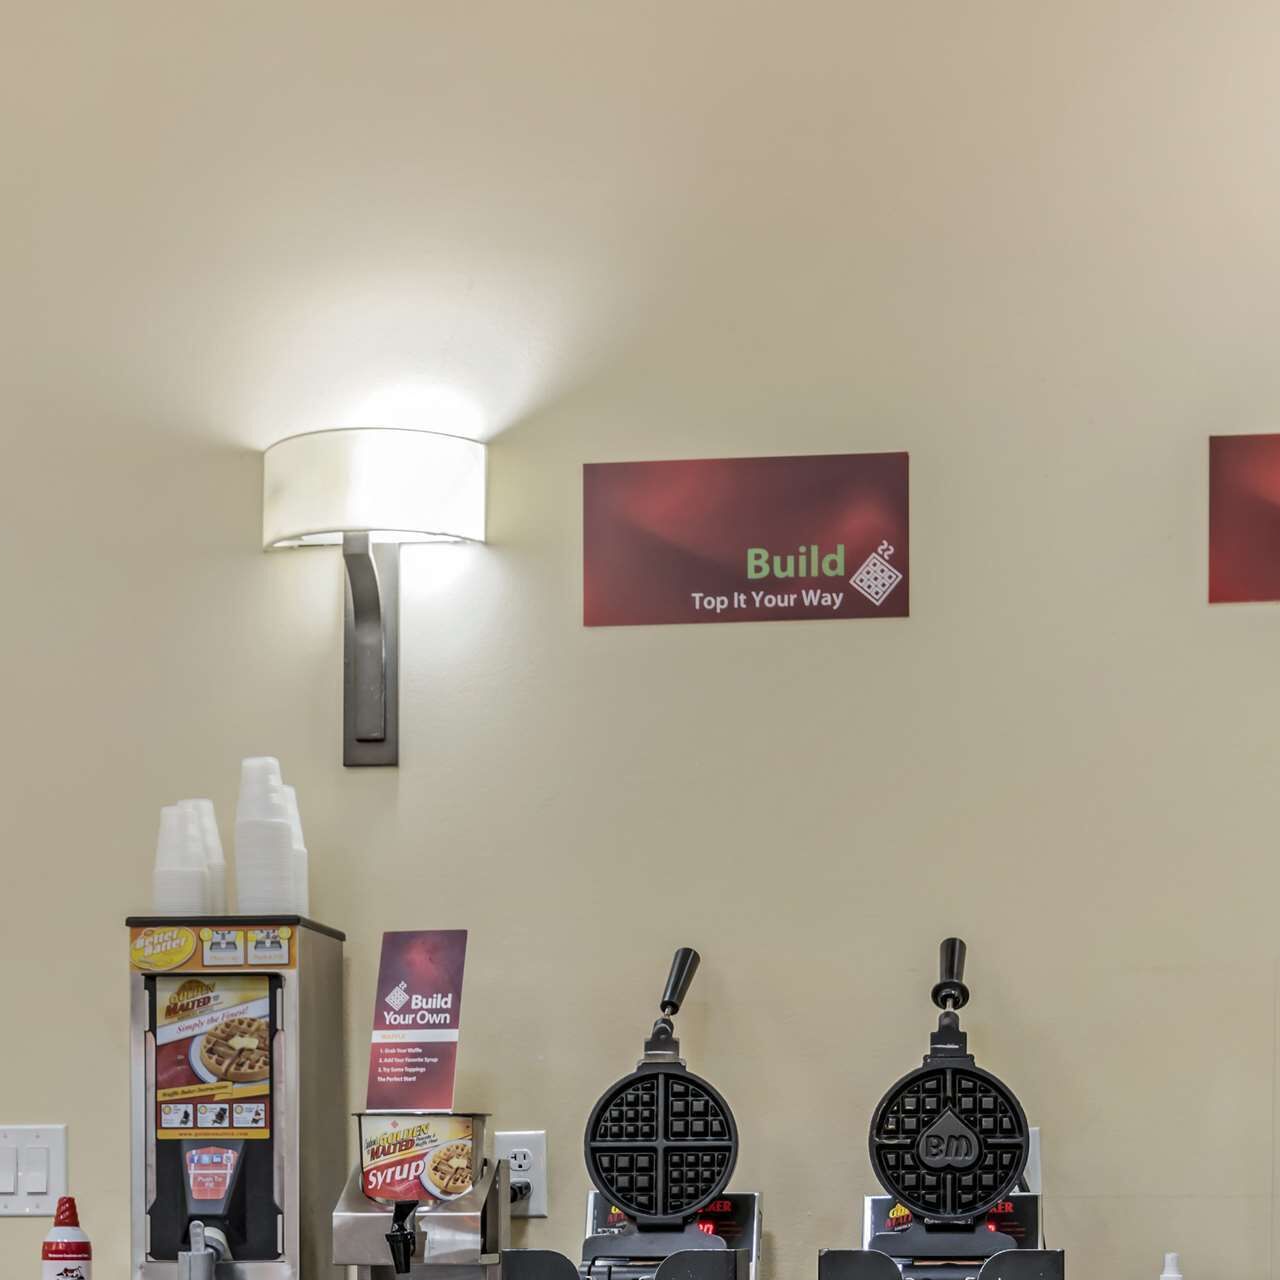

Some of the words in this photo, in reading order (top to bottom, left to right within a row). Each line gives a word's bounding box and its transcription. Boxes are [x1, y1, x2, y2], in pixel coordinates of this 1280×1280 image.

[746, 543, 846, 580] Build
[691, 592, 729, 613] Top
[733, 591, 747, 608] It
[751, 590, 798, 608] Your
[801, 589, 844, 610] Way
[165, 995, 212, 1019] MALTED
[411, 993, 452, 1009] Build
[384, 1010, 415, 1025] Your
[416, 1010, 450, 1024] Own
[379, 1123, 430, 1146] GOLDEN
[369, 1138, 416, 1161] MALTED
[367, 1160, 425, 1190] Syrup
